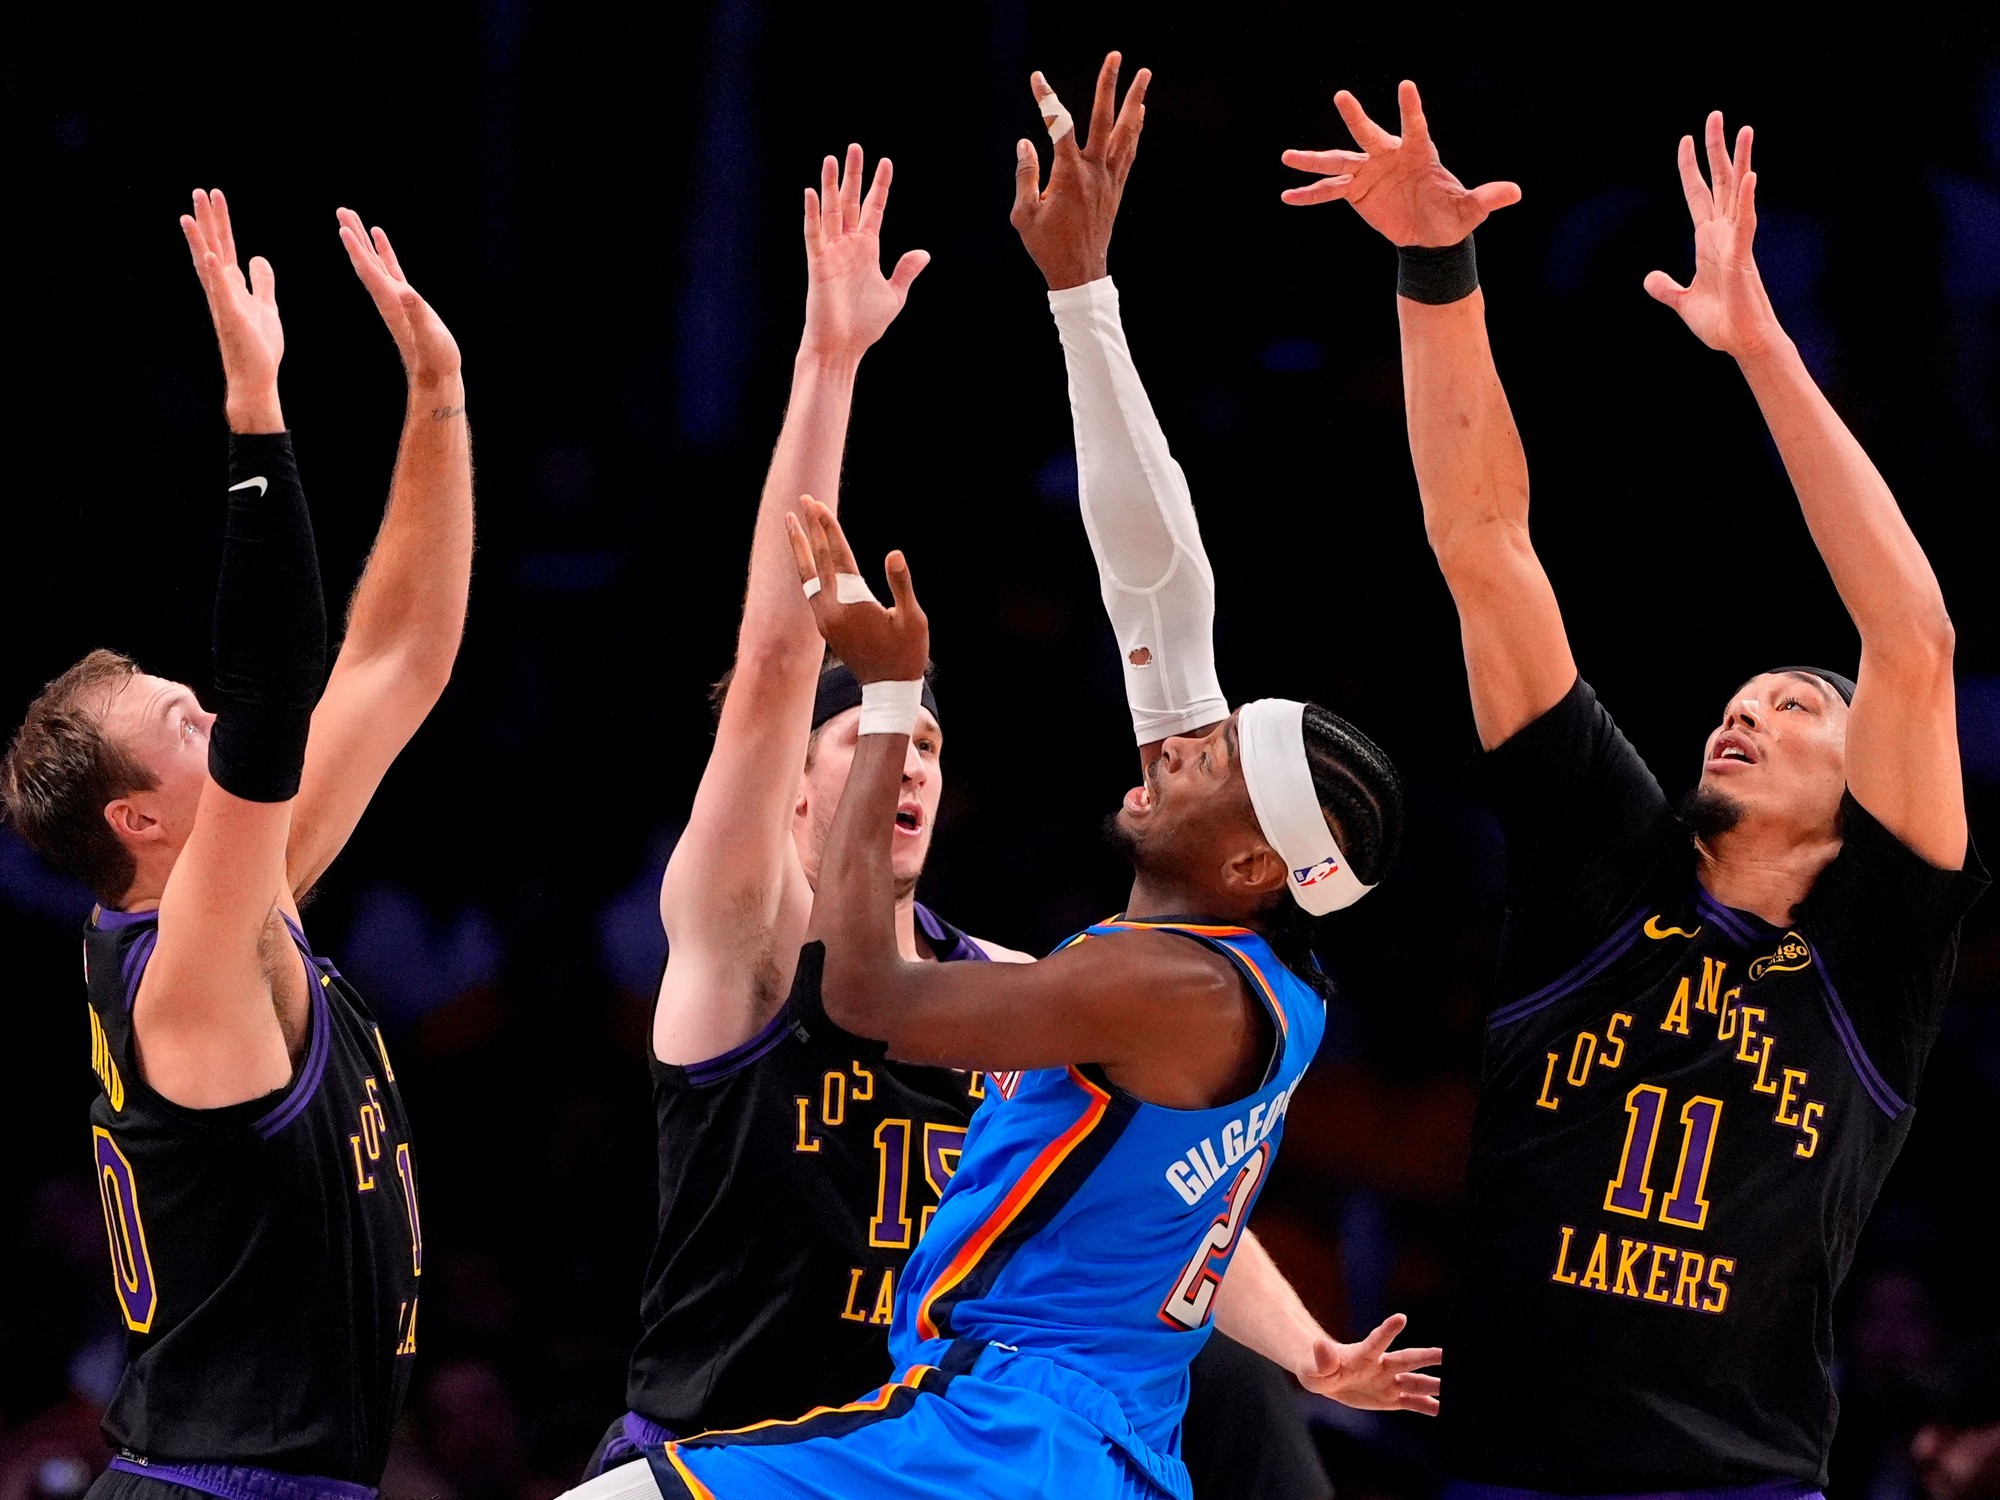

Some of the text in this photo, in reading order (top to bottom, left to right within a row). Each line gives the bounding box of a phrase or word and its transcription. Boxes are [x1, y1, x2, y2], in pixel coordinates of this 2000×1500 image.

[795, 1060, 874, 1152] LOS
[1536, 956, 1824, 1158] LOS ANGELES
[350, 1077, 386, 1191] LOS
[1603, 1083, 1723, 1231] 11
[92, 1124, 158, 1335] 0
[1156, 1141, 1271, 1333] 2
[1552, 1227, 1735, 1314] LAKERS
